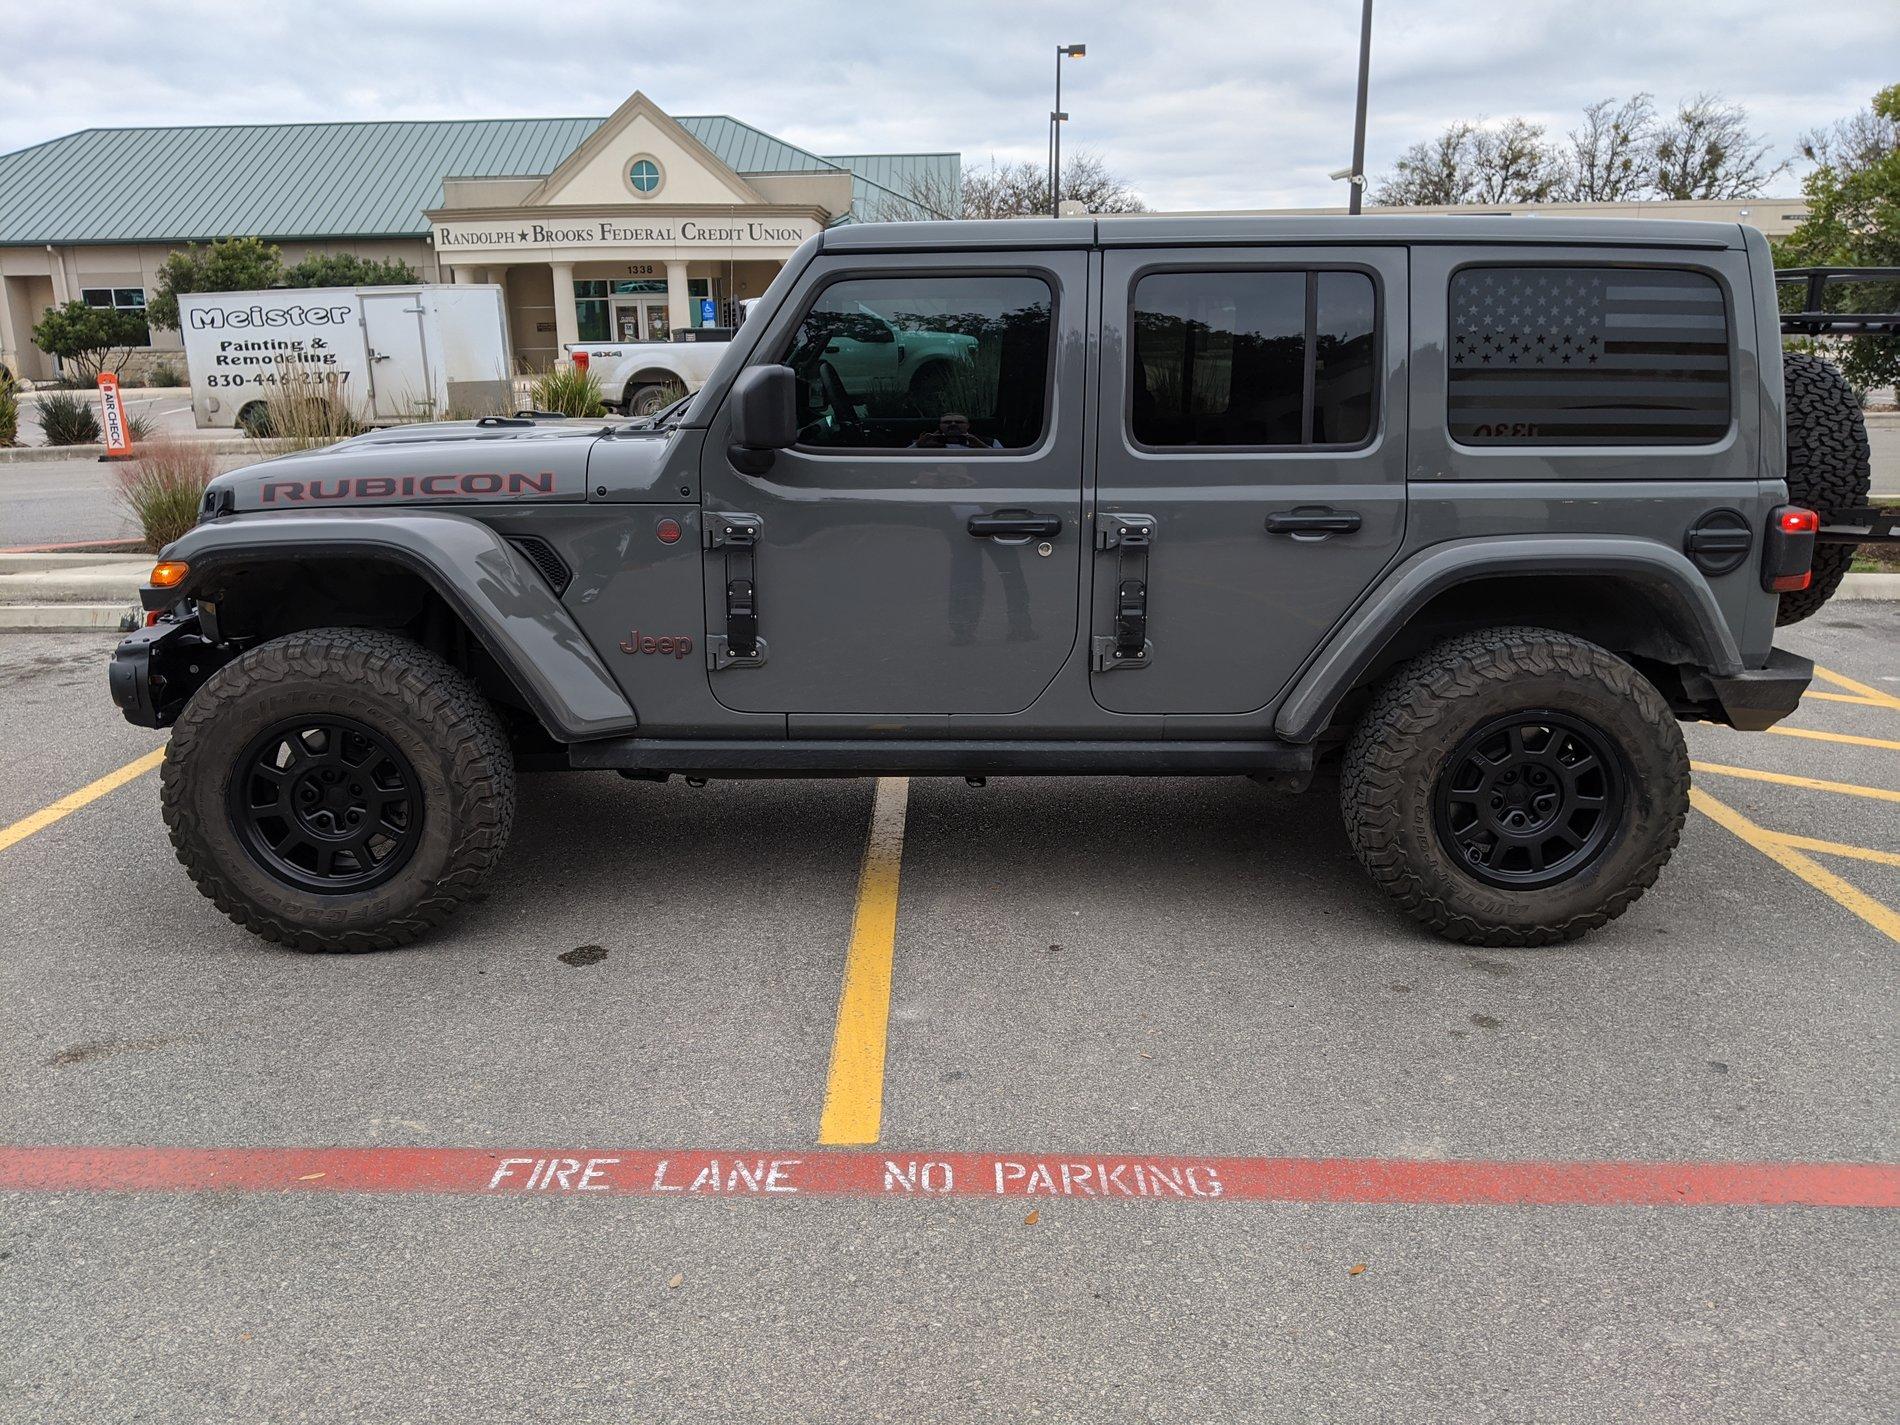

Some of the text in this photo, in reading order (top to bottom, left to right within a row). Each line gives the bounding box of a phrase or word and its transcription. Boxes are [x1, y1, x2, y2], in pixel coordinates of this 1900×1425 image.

[440, 222, 803, 246] RANDOLPH BROOKS FEDERAL CREDIT UNION
[626, 265, 653, 275] 1338
[190, 305, 351, 330] Meister
[220, 337, 328, 352] Painting &
[216, 352, 337, 366] Remodeling
[104, 393, 122, 447] AIR CHECK
[261, 471, 556, 504] RUBICON
[619, 630, 693, 660] Jeep
[487, 1157, 1223, 1197] FIRE LANE NO PARKING
